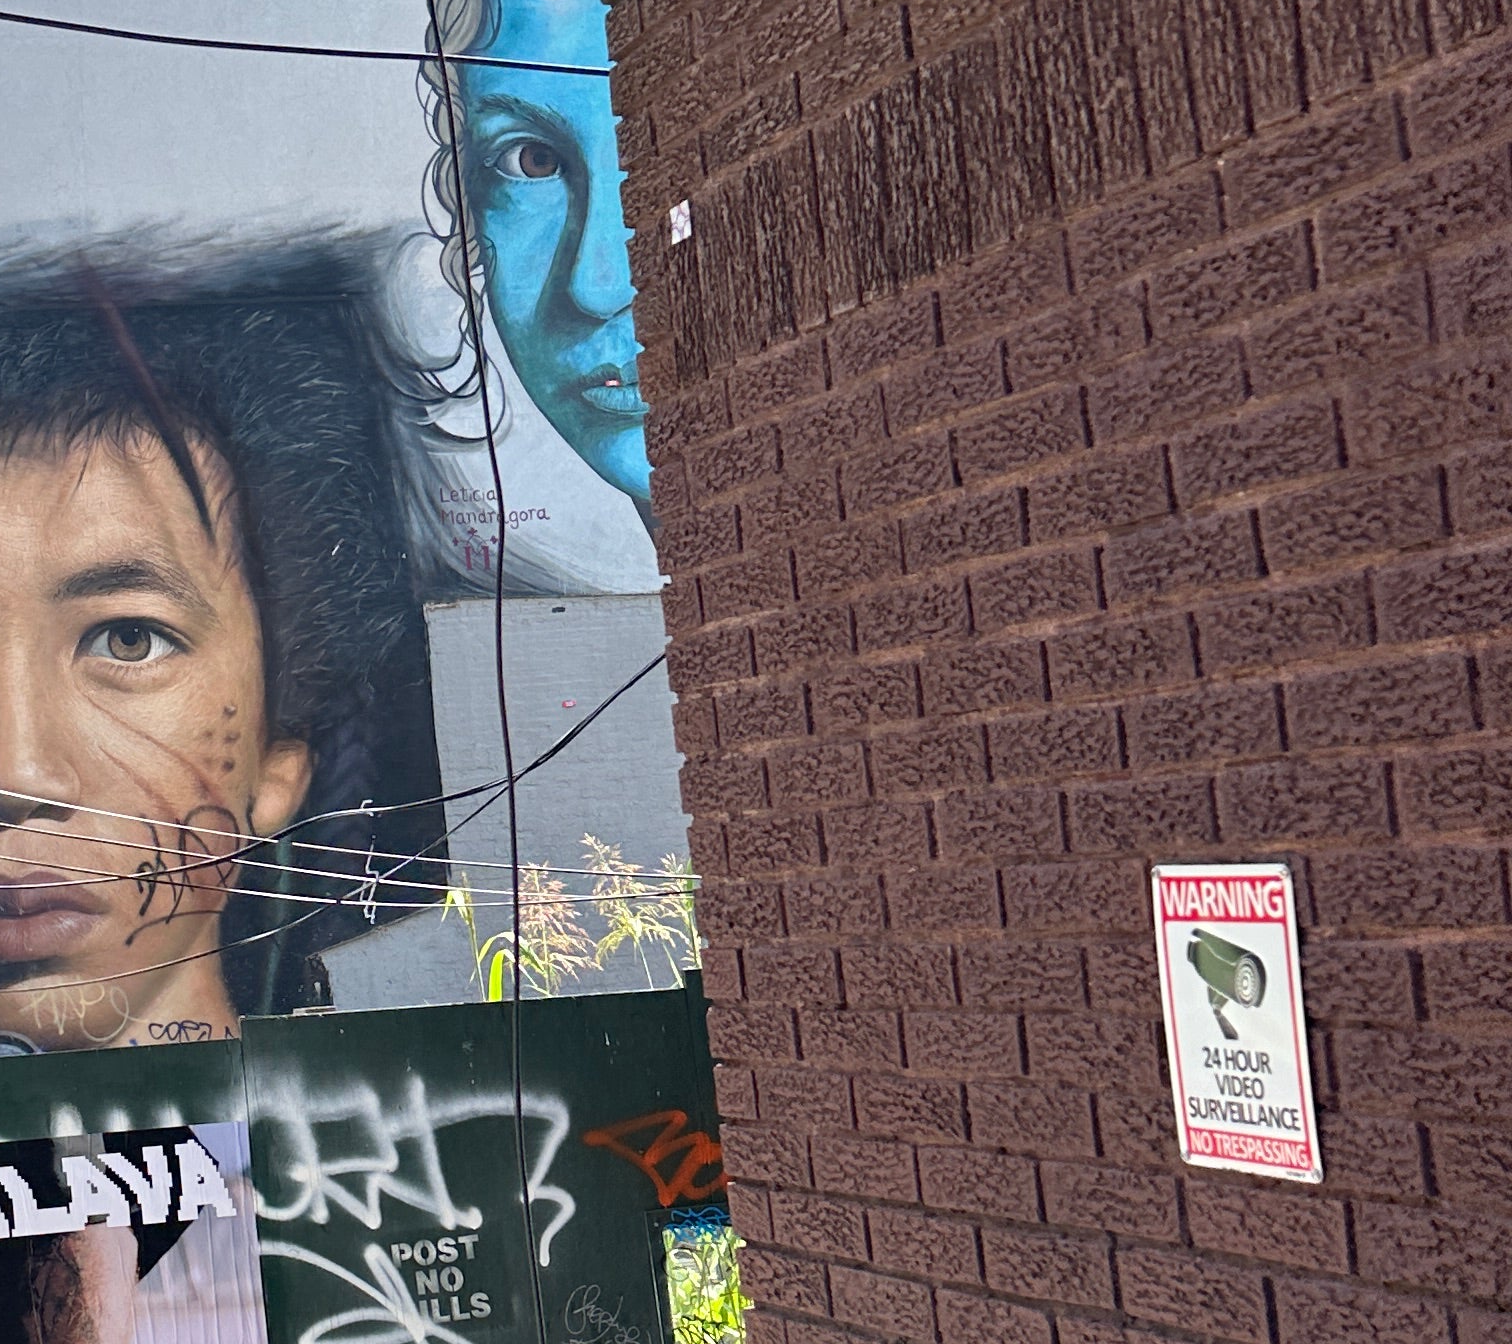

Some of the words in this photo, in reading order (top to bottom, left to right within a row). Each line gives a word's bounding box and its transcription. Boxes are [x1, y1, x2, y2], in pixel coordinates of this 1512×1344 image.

[439, 487, 497, 503] Leticia
[440, 506, 550, 529] Mandragora
[1160, 879, 1285, 919] WARNING
[1201, 1045, 1222, 1068] 24
[1223, 1047, 1272, 1075] HOUR
[1214, 1072, 1265, 1100] VIDEO
[1187, 1096, 1301, 1132] SURVEILLANCE
[1189, 1130, 1212, 1154] NO
[1213, 1133, 1309, 1169] TRESPASSING
[390, 1233, 480, 1268] POST
[415, 1265, 465, 1296] NO
[408, 1291, 492, 1323] ILLS
